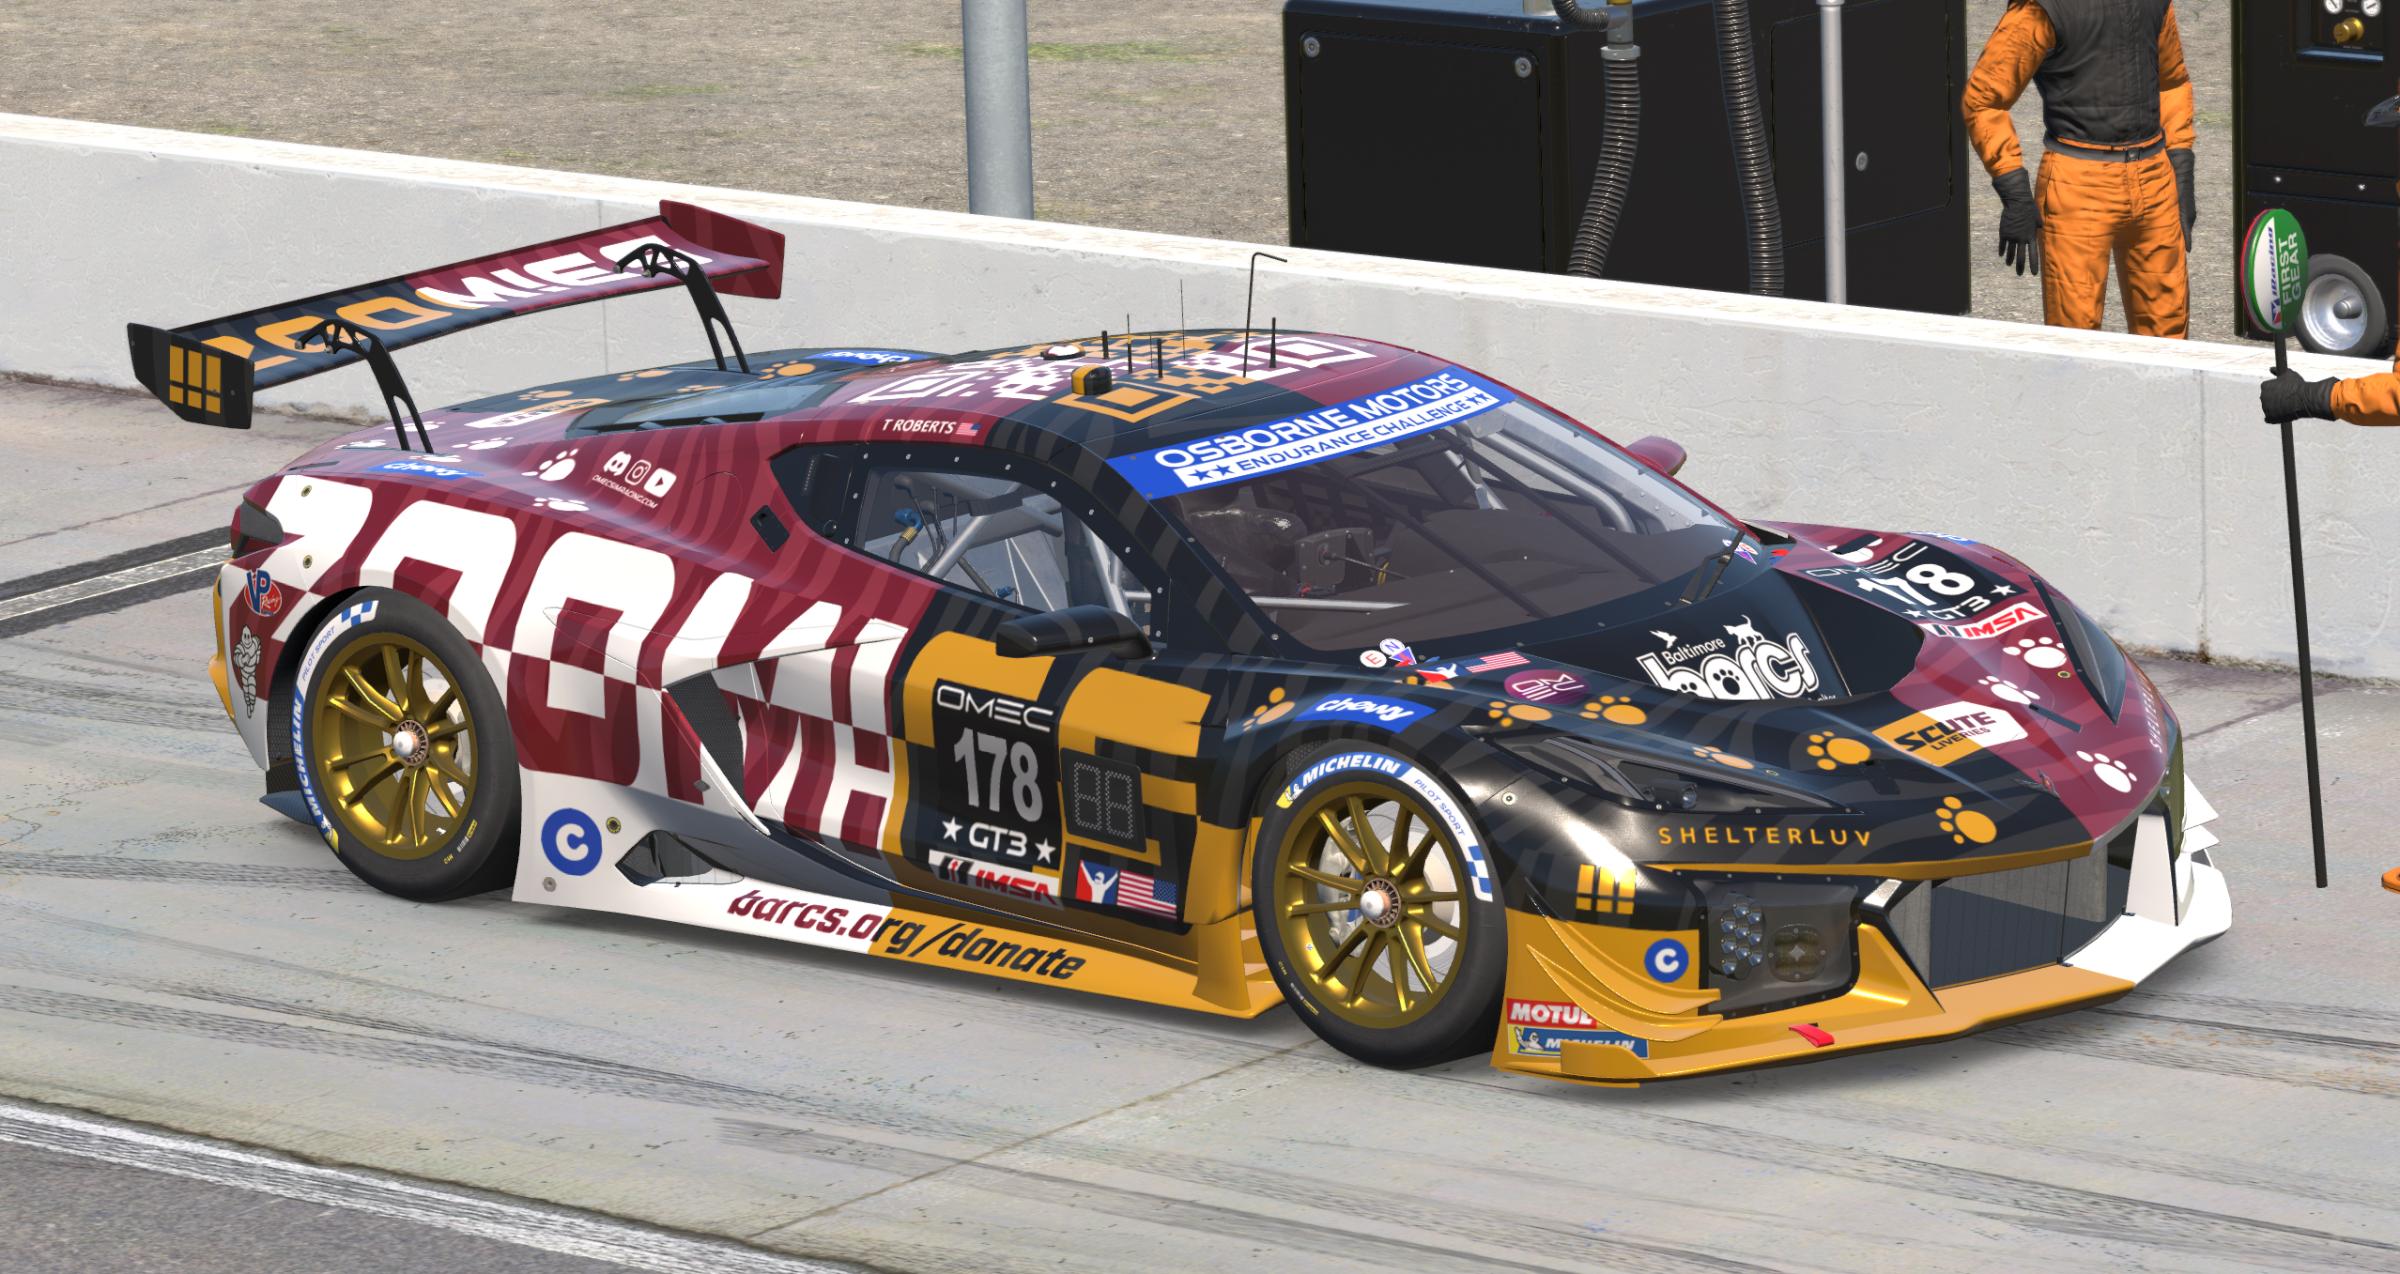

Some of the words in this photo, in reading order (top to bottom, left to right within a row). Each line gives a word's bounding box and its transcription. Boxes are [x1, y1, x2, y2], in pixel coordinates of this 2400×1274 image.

[2278, 238, 2293, 305] FIRST
[2287, 231, 2302, 300] GEAR
[882, 418, 893, 431] T
[894, 418, 957, 434] ROBERTS
[1154, 407, 1358, 470] OSBORNE
[1355, 373, 1471, 421] MOTORS
[1238, 430, 1375, 472] ENDURANCE
[1373, 399, 1470, 436] CHALLENGE
[1855, 563, 1975, 607] 178
[1927, 595, 1991, 621] GT3
[1962, 607, 2041, 638] IMSA
[302, 653, 317, 682] PILOT
[315, 626, 336, 653] SPORT
[1661, 637, 1727, 666] Baltimore
[936, 684, 1054, 733] OMEC
[1315, 697, 1414, 722] chewy
[1894, 711, 1997, 752] SCUTE
[1931, 727, 1992, 751] LIVERIES
[292, 698, 323, 818] MICHELIN
[953, 726, 1044, 823] 178
[1302, 754, 1402, 787] MICHELIN
[1413, 778, 1441, 804] PILOT
[1439, 801, 1467, 837] SPORT
[968, 821, 1028, 857] GT3
[1657, 826, 1871, 847] SHELTERLUV
[975, 869, 1058, 905] IMSA
[726, 888, 1087, 981] barcs.org/donate
[1510, 1002, 1593, 1025] MOTUL
